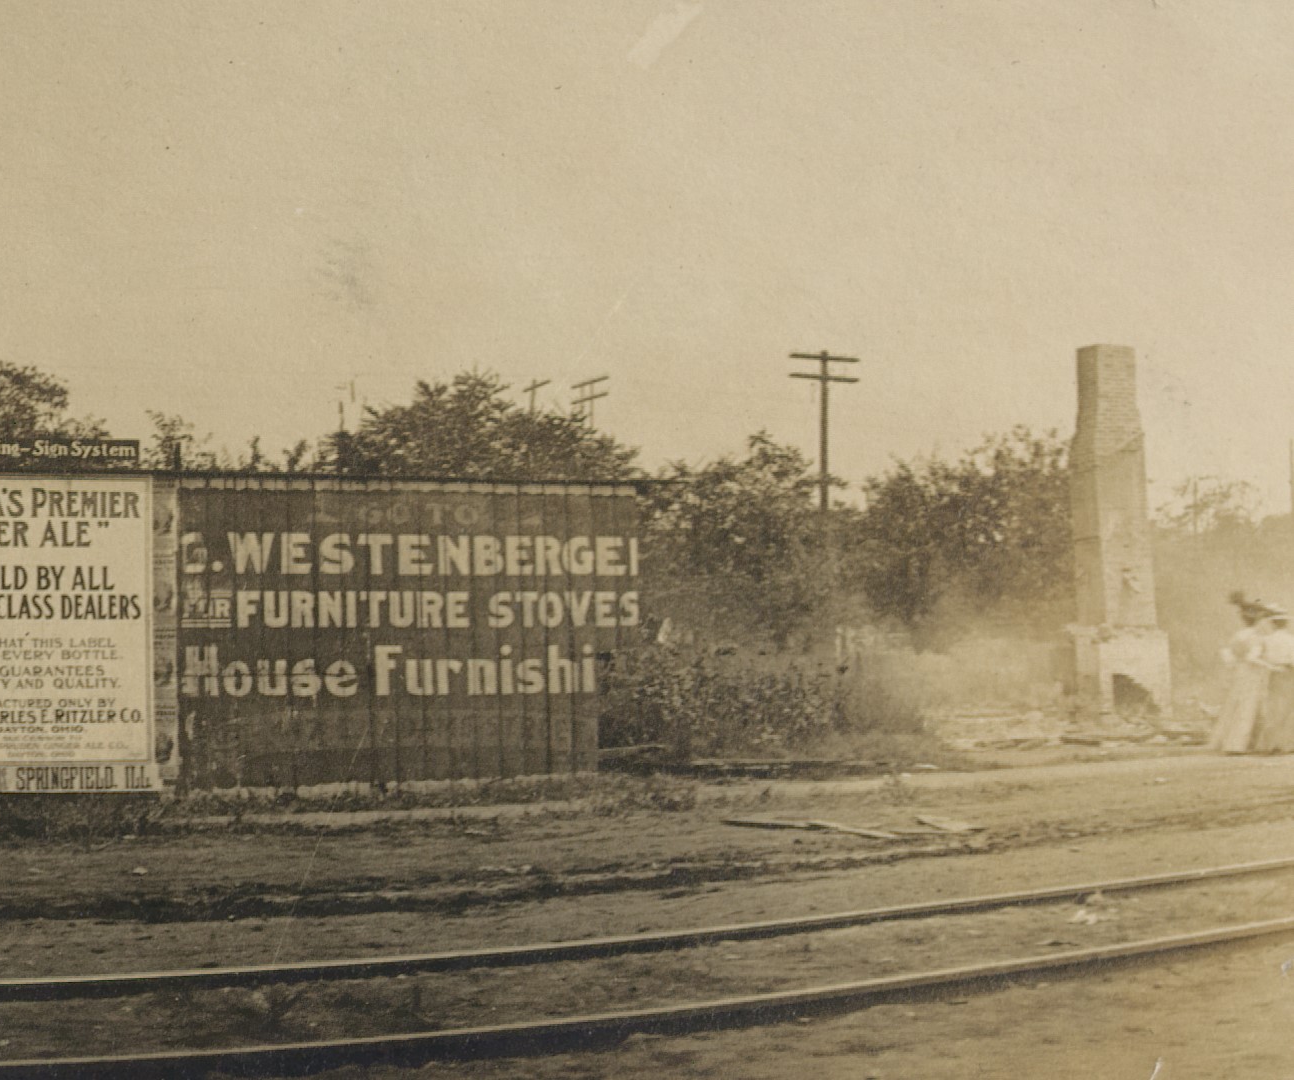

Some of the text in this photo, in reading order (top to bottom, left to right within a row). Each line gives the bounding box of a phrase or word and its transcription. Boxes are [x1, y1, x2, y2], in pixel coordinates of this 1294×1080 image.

[70, 441, 136, 459] System
[31, 487, 141, 519] PREMIER
[425, 502, 479, 526] TO
[36, 565, 65, 591] BY
[71, 566, 116, 591] ALL
[61, 594, 143, 621] DEALERS
[236, 590, 471, 629] FURNITURE
[488, 590, 639, 628] STOVES
[31, 637, 63, 649] THIS
[69, 637, 116, 649] LABEL
[2, 649, 54, 661] EVERY
[61, 649, 124, 661] BOTTLE.
[181, 643, 596, 698] House Furnishi
[16, 678, 45, 689] AND
[52, 677, 122, 690] QUALITY.
[57, 699, 92, 709] ONLY
[97, 699, 115, 709] BY
[54, 709, 116, 724] RITZLER
[119, 708, 144, 723] CO.
